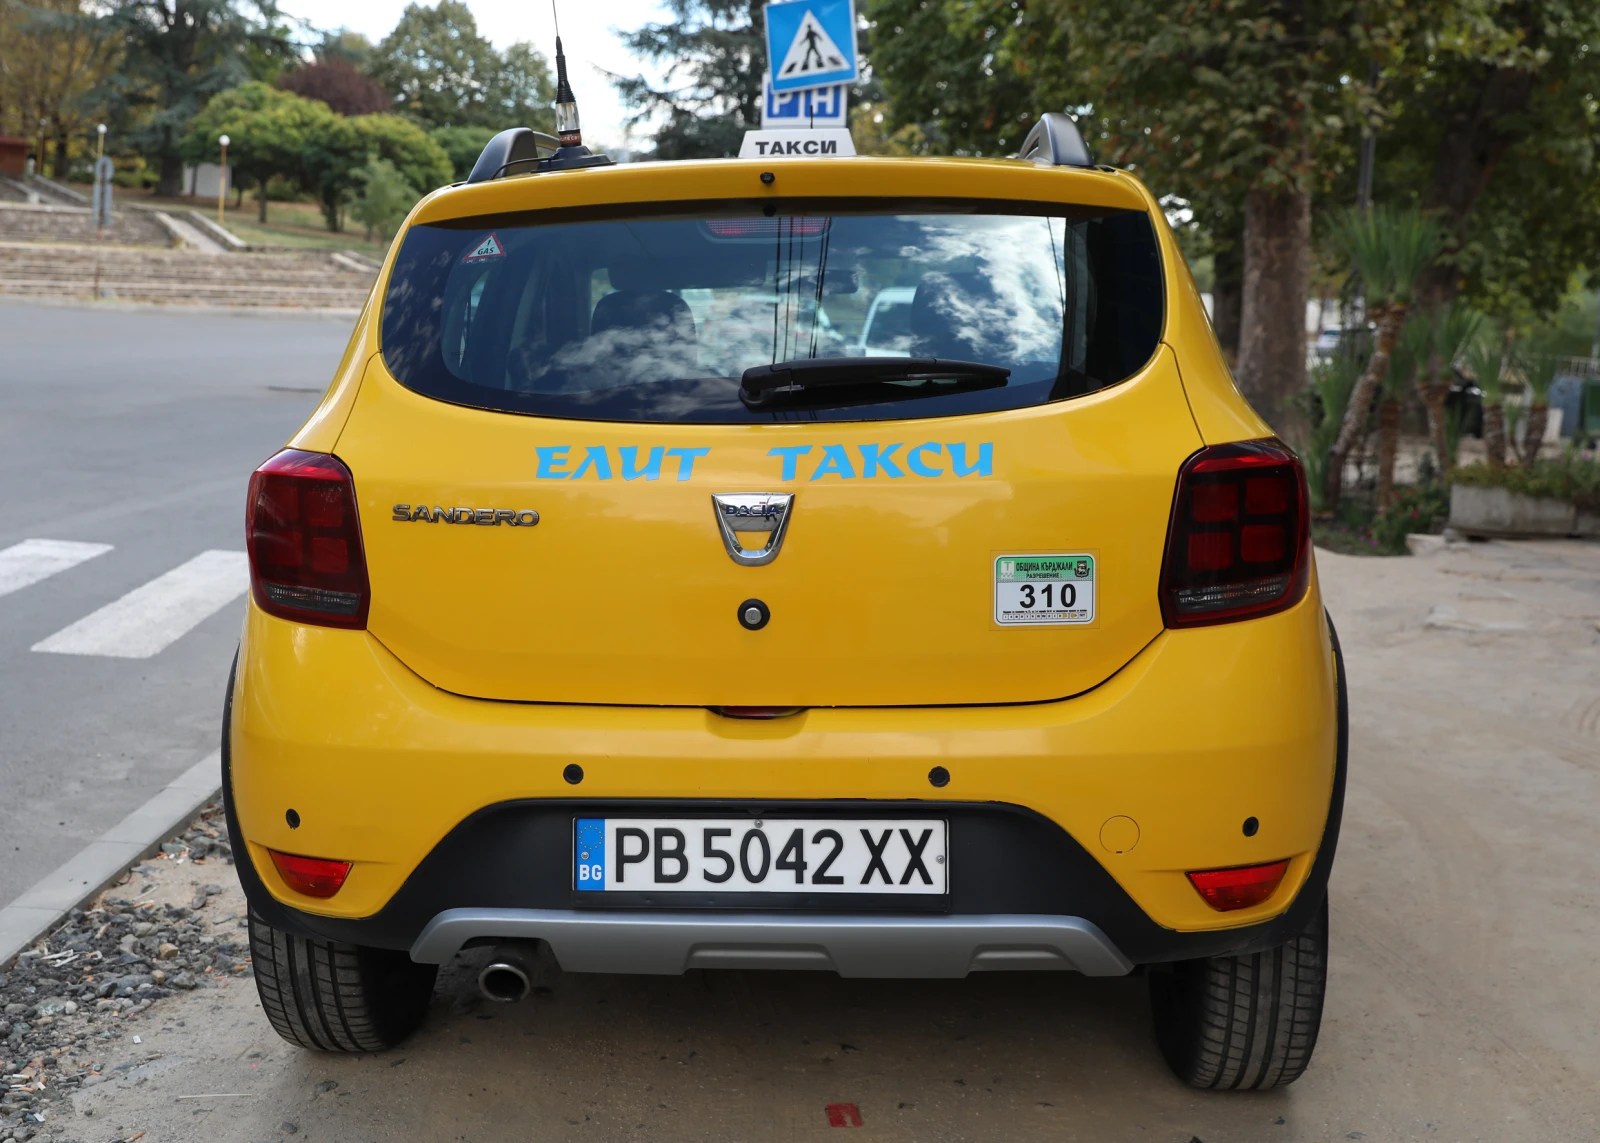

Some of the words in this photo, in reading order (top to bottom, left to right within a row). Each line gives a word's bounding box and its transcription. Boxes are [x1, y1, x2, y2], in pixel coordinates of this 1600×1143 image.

[755, 140, 837, 155] ТАКСИ
[477, 247, 494, 255] GAS
[534, 445, 712, 482] ЕЛИТ
[766, 441, 994, 482] ТАКСИ
[392, 504, 540, 526] SANDERO
[725, 505, 780, 515] DACIA
[1016, 562, 1040, 572] ОБЩИНА
[1041, 561, 1073, 572] КЪРДЖАЛИ
[1019, 583, 1076, 608] 310
[615, 828, 689, 883] PB
[703, 828, 844, 884] 5042
[860, 829, 934, 885] XX
[579, 864, 602, 881] BG
